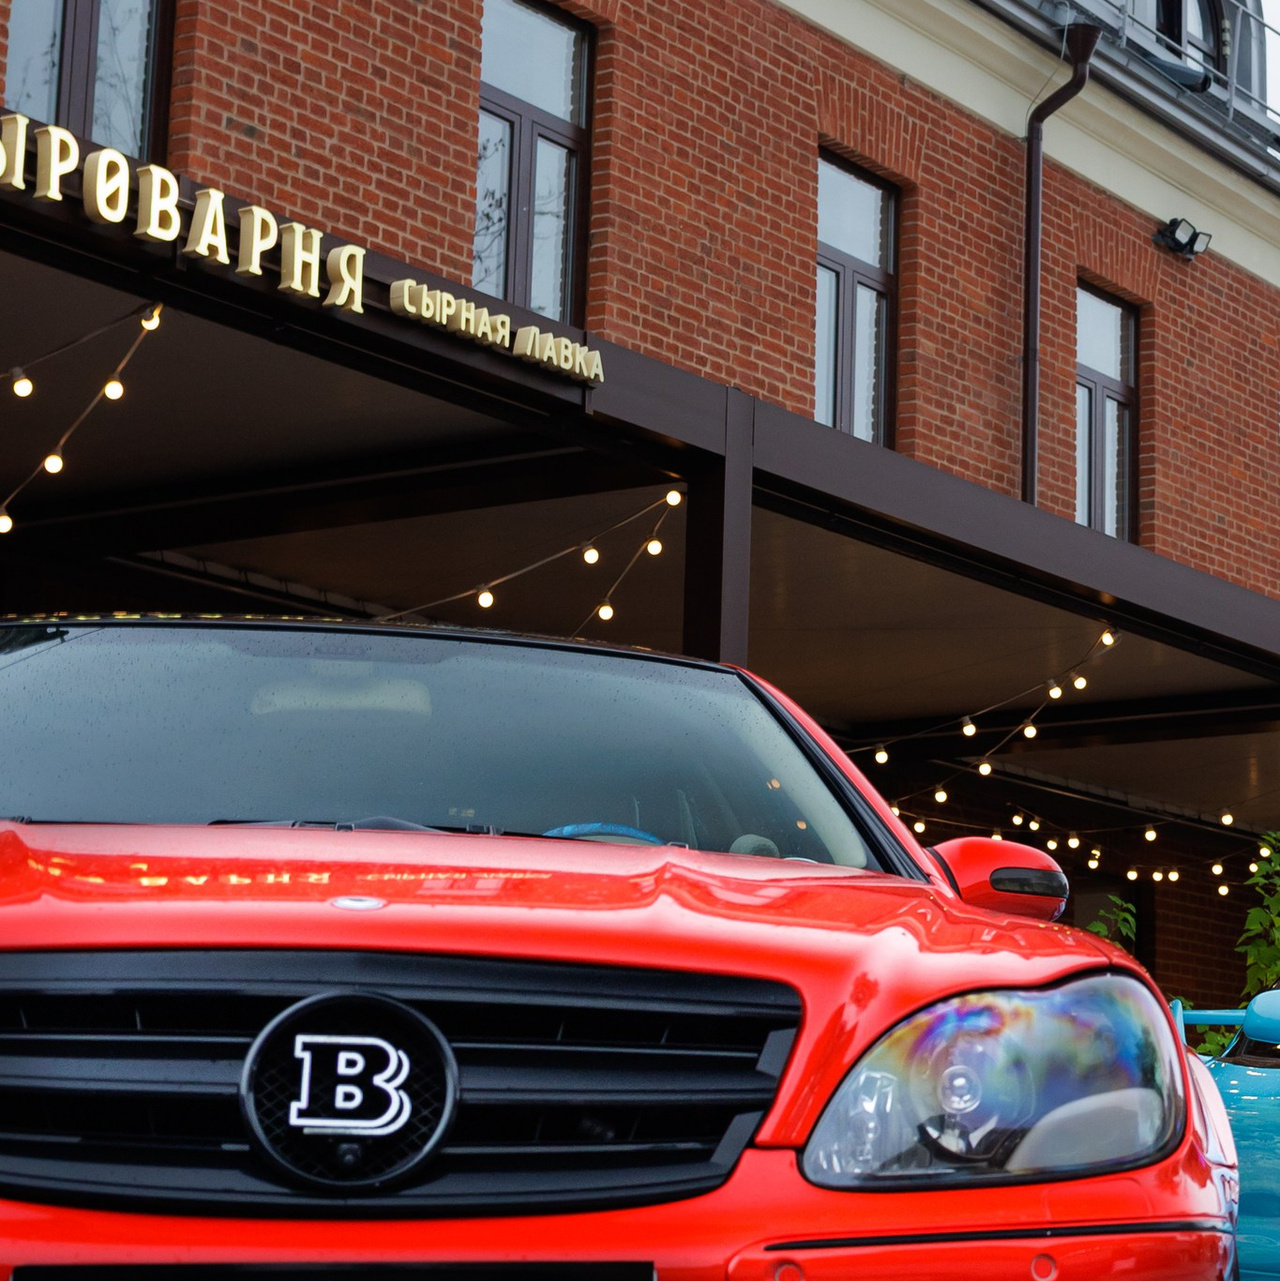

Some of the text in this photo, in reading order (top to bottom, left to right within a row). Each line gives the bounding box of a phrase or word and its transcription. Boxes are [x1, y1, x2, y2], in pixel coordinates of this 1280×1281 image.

[393, 278, 511, 349] СЫРНАЯ
[517, 325, 605, 383] ЛАВКА
[289, 1034, 412, 1136] B
